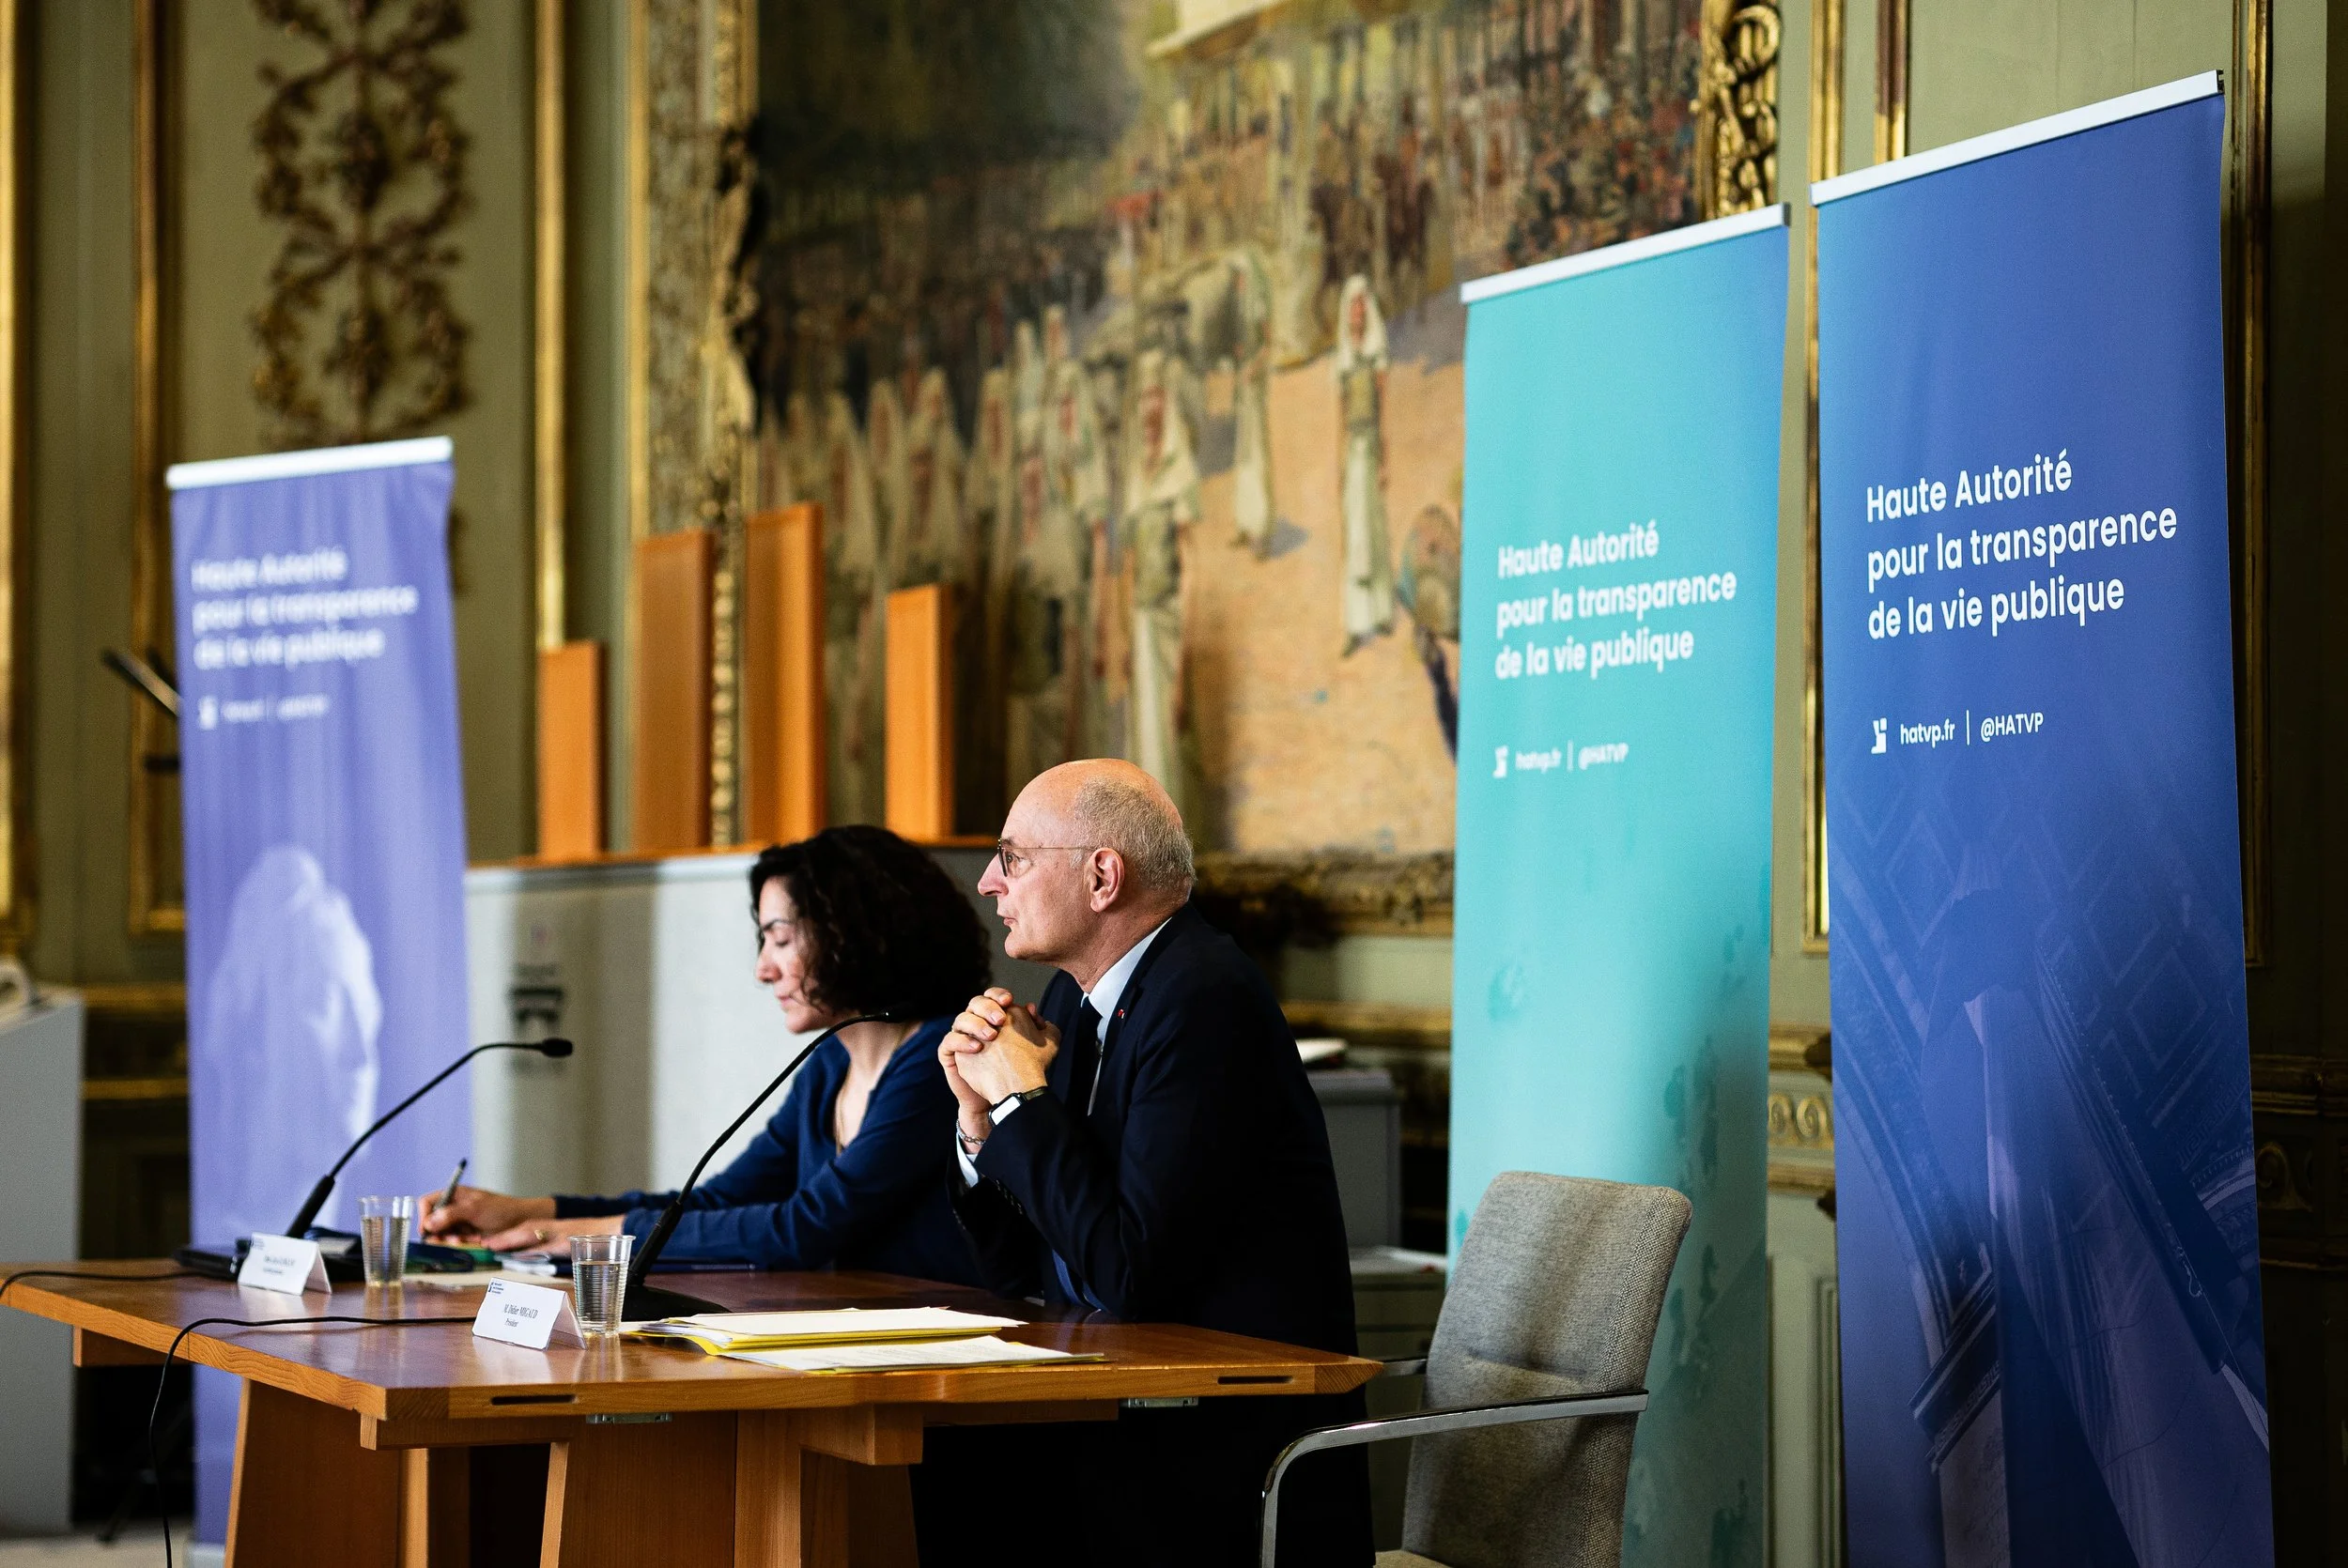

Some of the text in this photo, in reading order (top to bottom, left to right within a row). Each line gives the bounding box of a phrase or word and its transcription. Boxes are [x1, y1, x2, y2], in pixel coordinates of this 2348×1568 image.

[1866, 448, 2072, 523] Haute Autorité
[1498, 519, 1660, 578] Haute Autorité
[1867, 507, 2177, 594] pour la transparence
[1496, 572, 1738, 639] pour la transparence
[1868, 575, 2124, 639] de la vie publique
[1495, 626, 1694, 680] de la vie publique
[1900, 712, 2044, 748] hatvp.fr @HATVP
